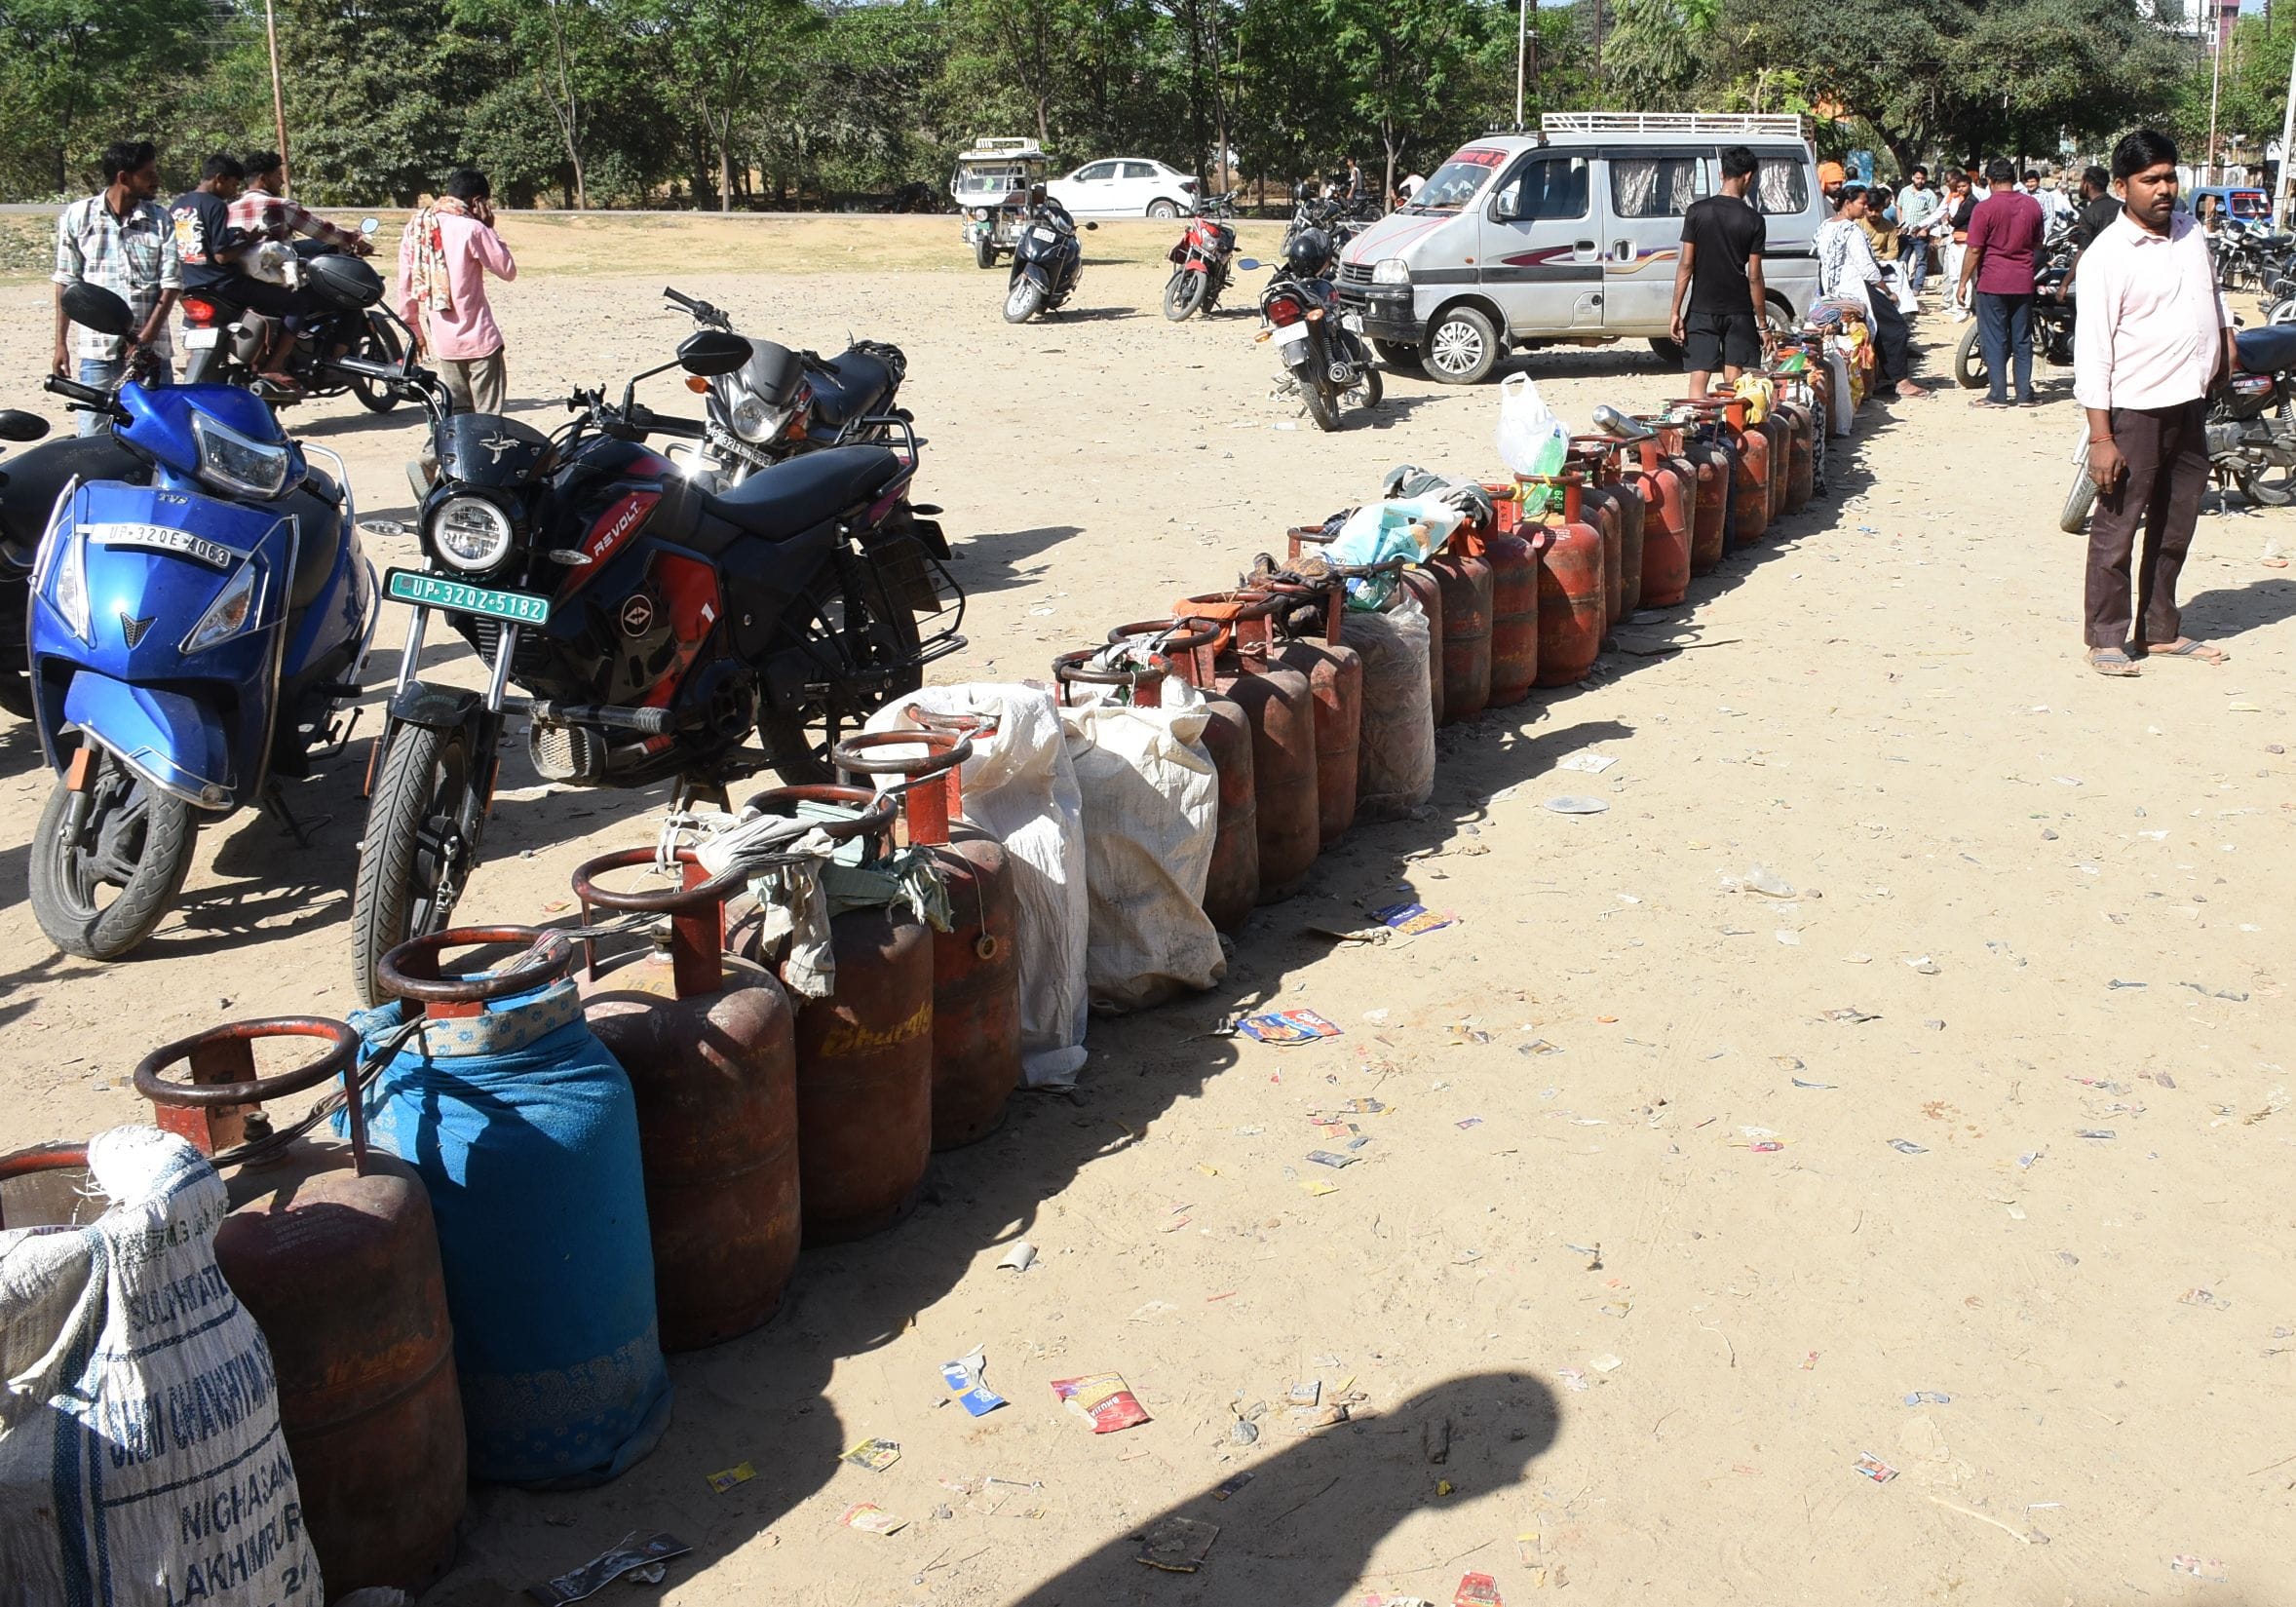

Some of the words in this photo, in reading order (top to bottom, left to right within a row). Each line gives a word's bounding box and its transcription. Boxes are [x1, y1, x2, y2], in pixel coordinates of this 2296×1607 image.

[722, 437, 744, 454] 32FL
[158, 492, 189, 505] TVS
[593, 501, 639, 557] REVOLT
[413, 579, 435, 598] UP
[442, 586, 489, 610] 32QZ
[496, 594, 542, 619] 5182
[1090, 1396, 1121, 1417] BHUJIA
